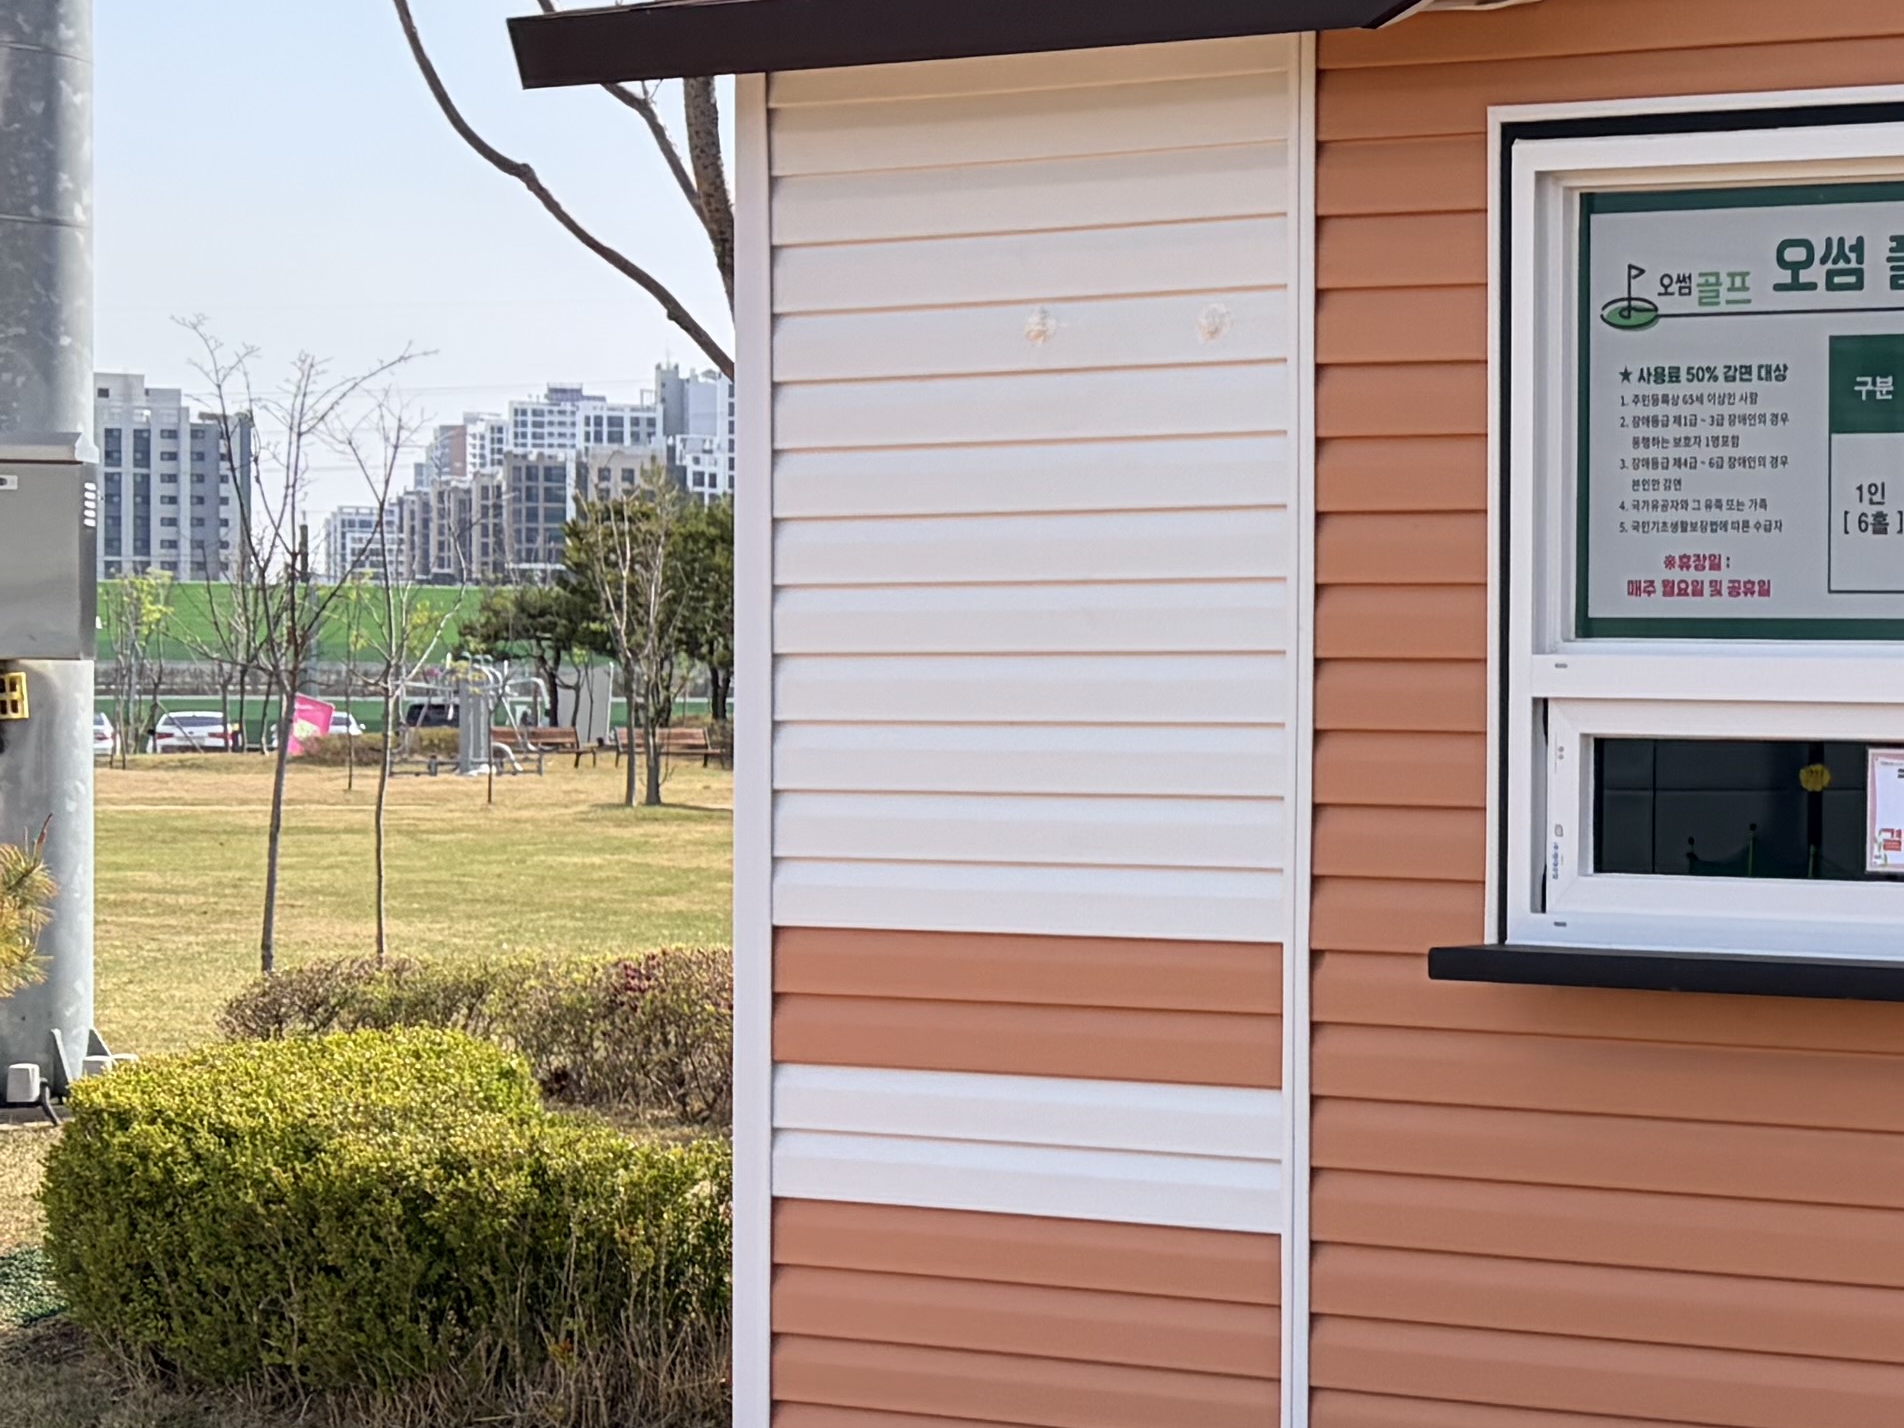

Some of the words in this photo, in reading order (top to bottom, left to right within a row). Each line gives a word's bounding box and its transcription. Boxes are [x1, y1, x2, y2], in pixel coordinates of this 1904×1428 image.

[1773, 235, 1865, 292] 오썸
[1638, 366, 1681, 385] 사용료
[1686, 365, 1718, 383] 50%
[1723, 365, 1753, 382] 감면
[1757, 364, 1788, 382] 대상
[1854, 376, 1894, 401] 구분
[1856, 482, 1886, 507] 1인
[1857, 511, 1890, 535] 6홀
[1627, 579, 1656, 597] 매주
[1662, 579, 1704, 597] 월요일
[1709, 579, 1723, 597] 및
[1727, 579, 1771, 597] 공휴일
